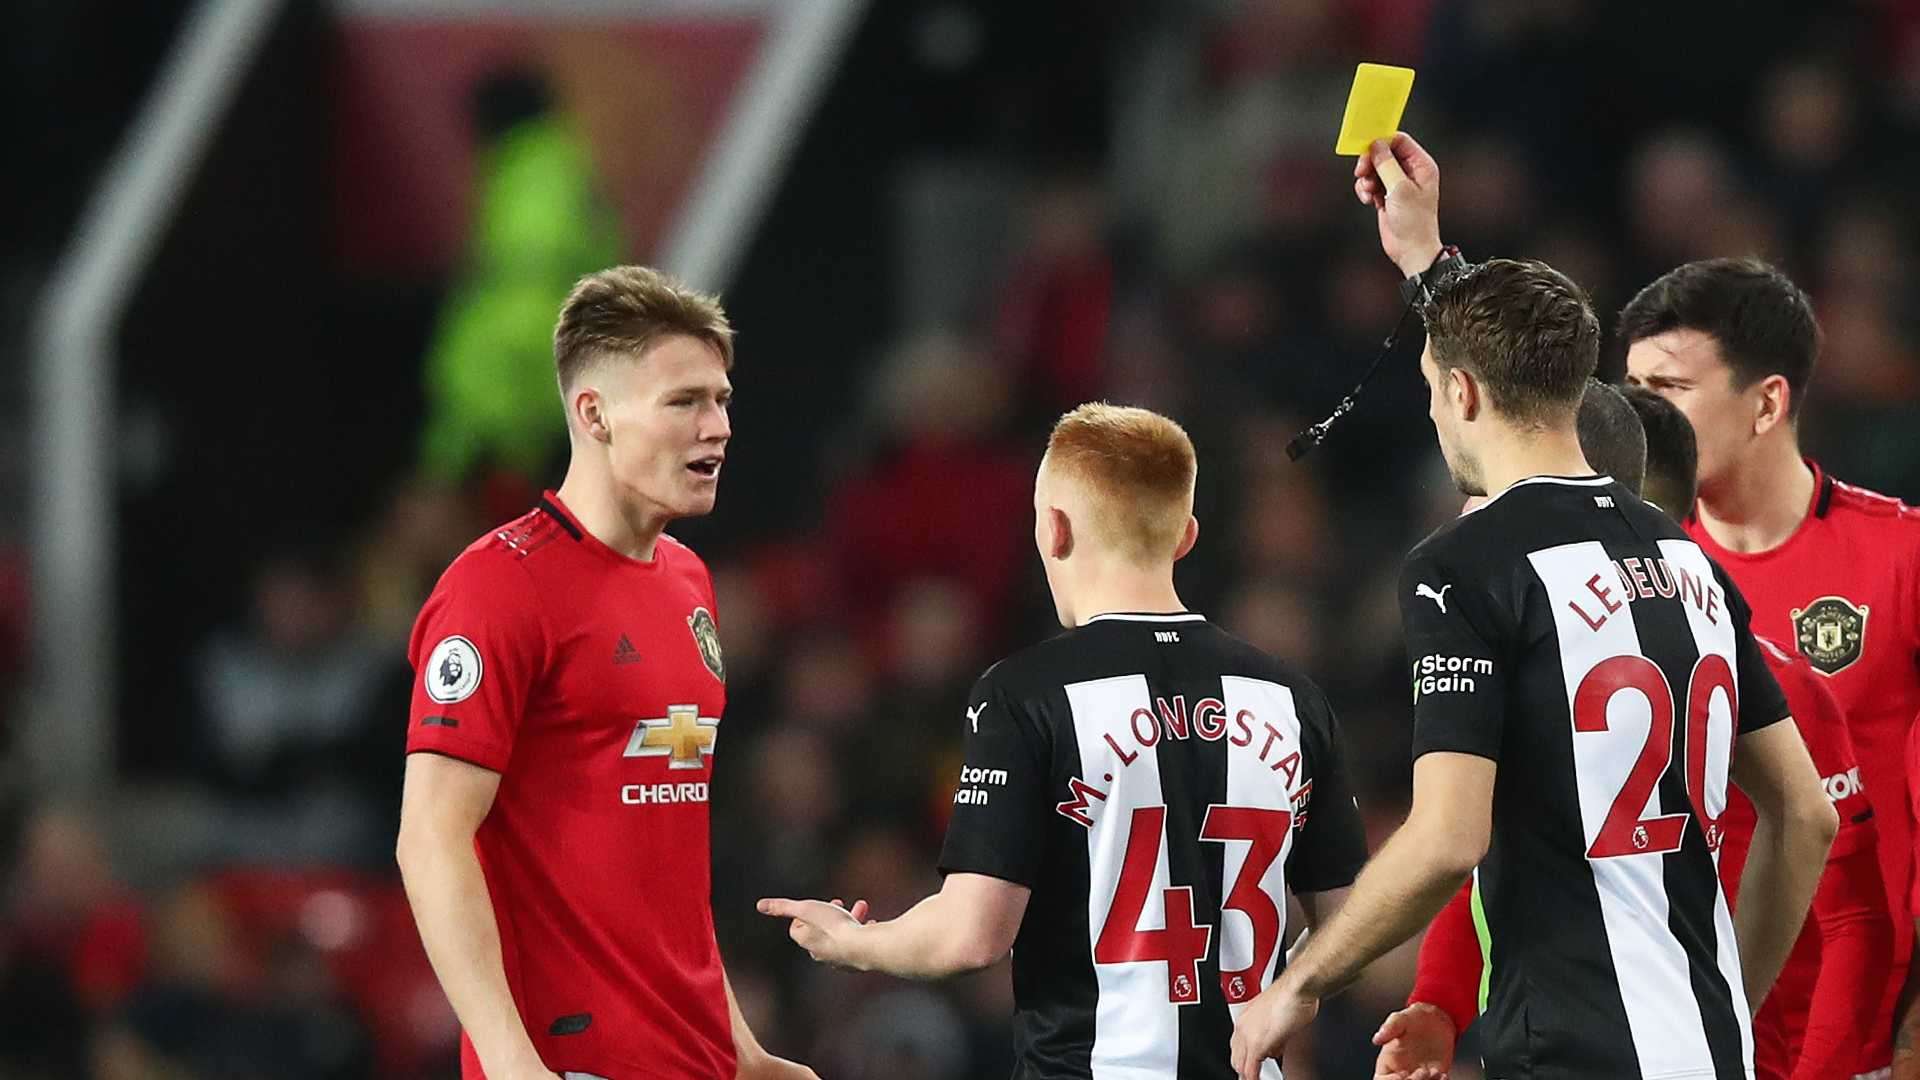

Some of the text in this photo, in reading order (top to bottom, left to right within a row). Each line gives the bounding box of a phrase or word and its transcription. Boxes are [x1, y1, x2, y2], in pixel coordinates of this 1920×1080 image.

[1568, 557, 1718, 632] LEJEUNE
[1421, 653, 1493, 675] Storm
[1421, 673, 1475, 695] Gain
[1571, 653, 1739, 859] 20
[953, 785, 988, 805] ain
[1056, 773, 1113, 829] M.
[1093, 803, 1294, 1005] 43
